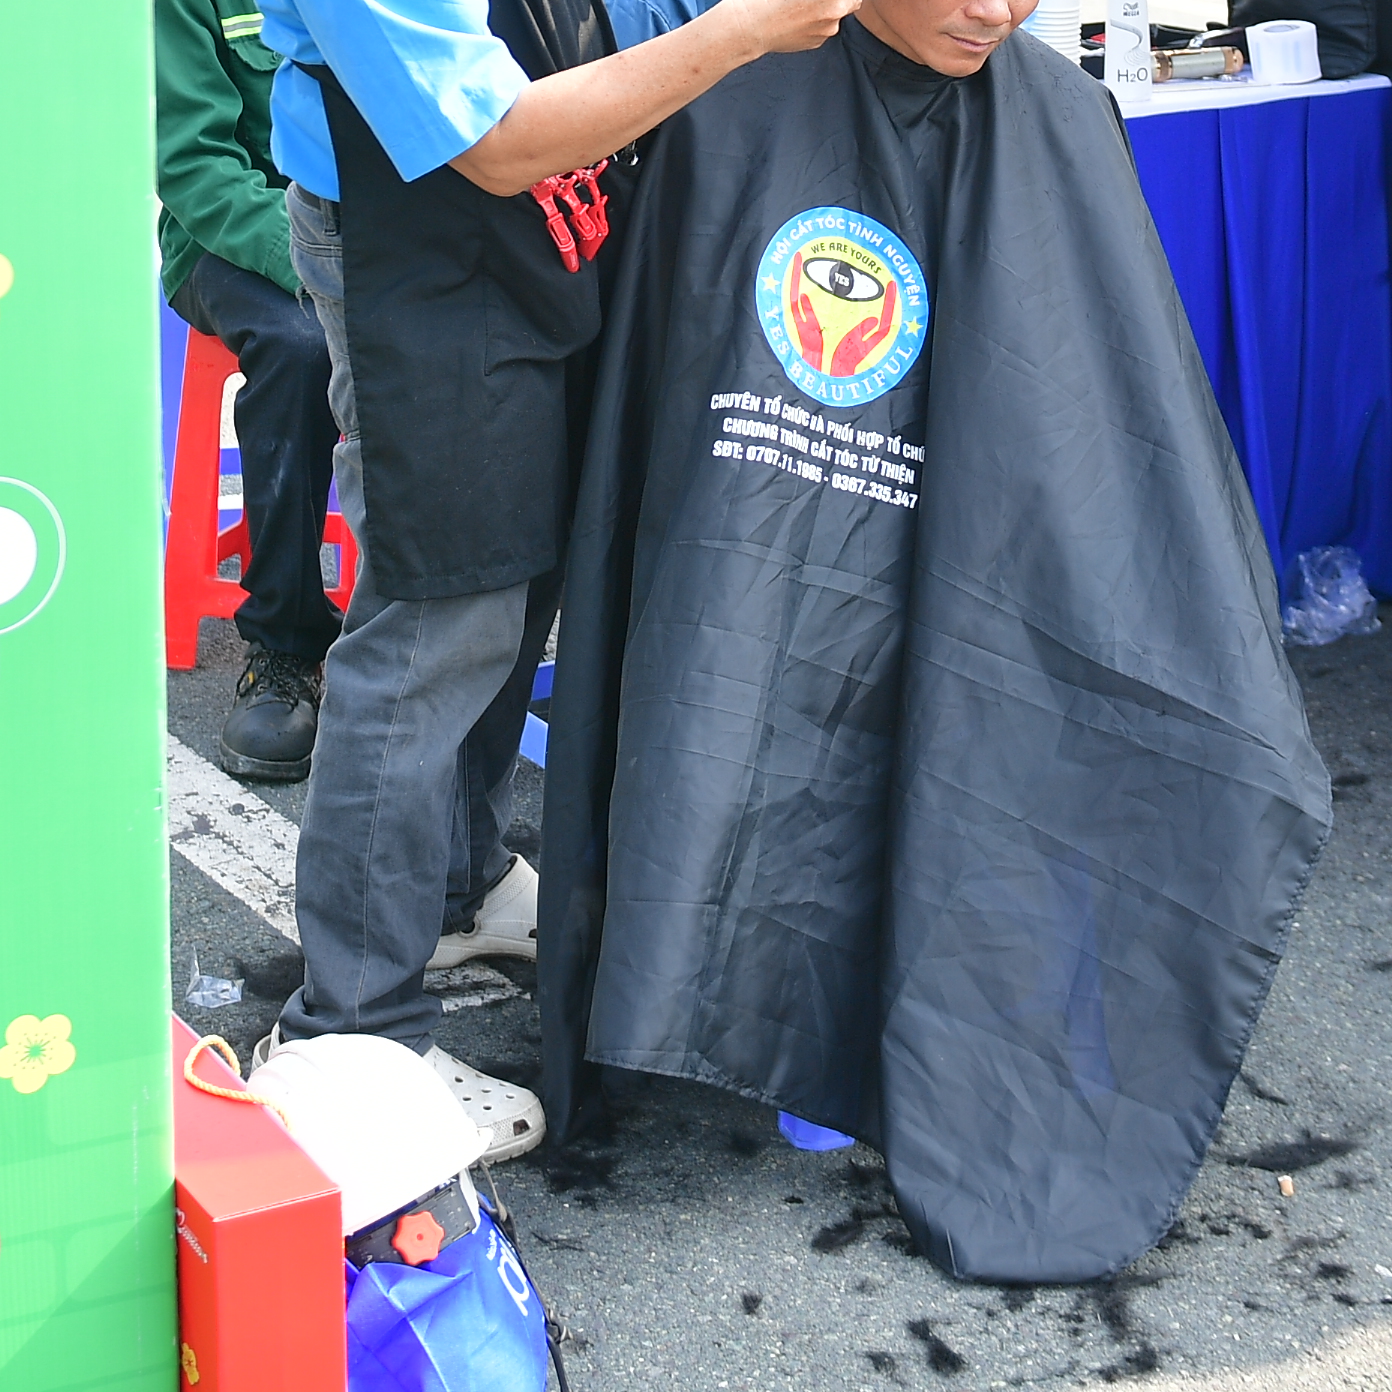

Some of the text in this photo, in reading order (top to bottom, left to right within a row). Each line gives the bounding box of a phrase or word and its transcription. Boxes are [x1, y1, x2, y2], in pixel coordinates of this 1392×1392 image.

[770, 215, 921, 307] HỘI CẮT TÓC TÌNH NGUYỆN
[810, 242, 882, 275] WE ARE YOURS
[834, 272, 850, 287] YES
[764, 304, 914, 402] YES BEAUTIFUL
[710, 391, 761, 412] CHUYÊN
[764, 394, 783, 415] TỔ
[781, 403, 811, 427] CHỨC
[826, 420, 855, 442] PHỐI
[856, 430, 885, 452] HỢP
[886, 434, 902, 456] TỔ
[712, 439, 744, 460] SĐT:
[722, 416, 916, 485] CHƯƠNG TRÌNH CẮT TÓC TỪ THIỆN
